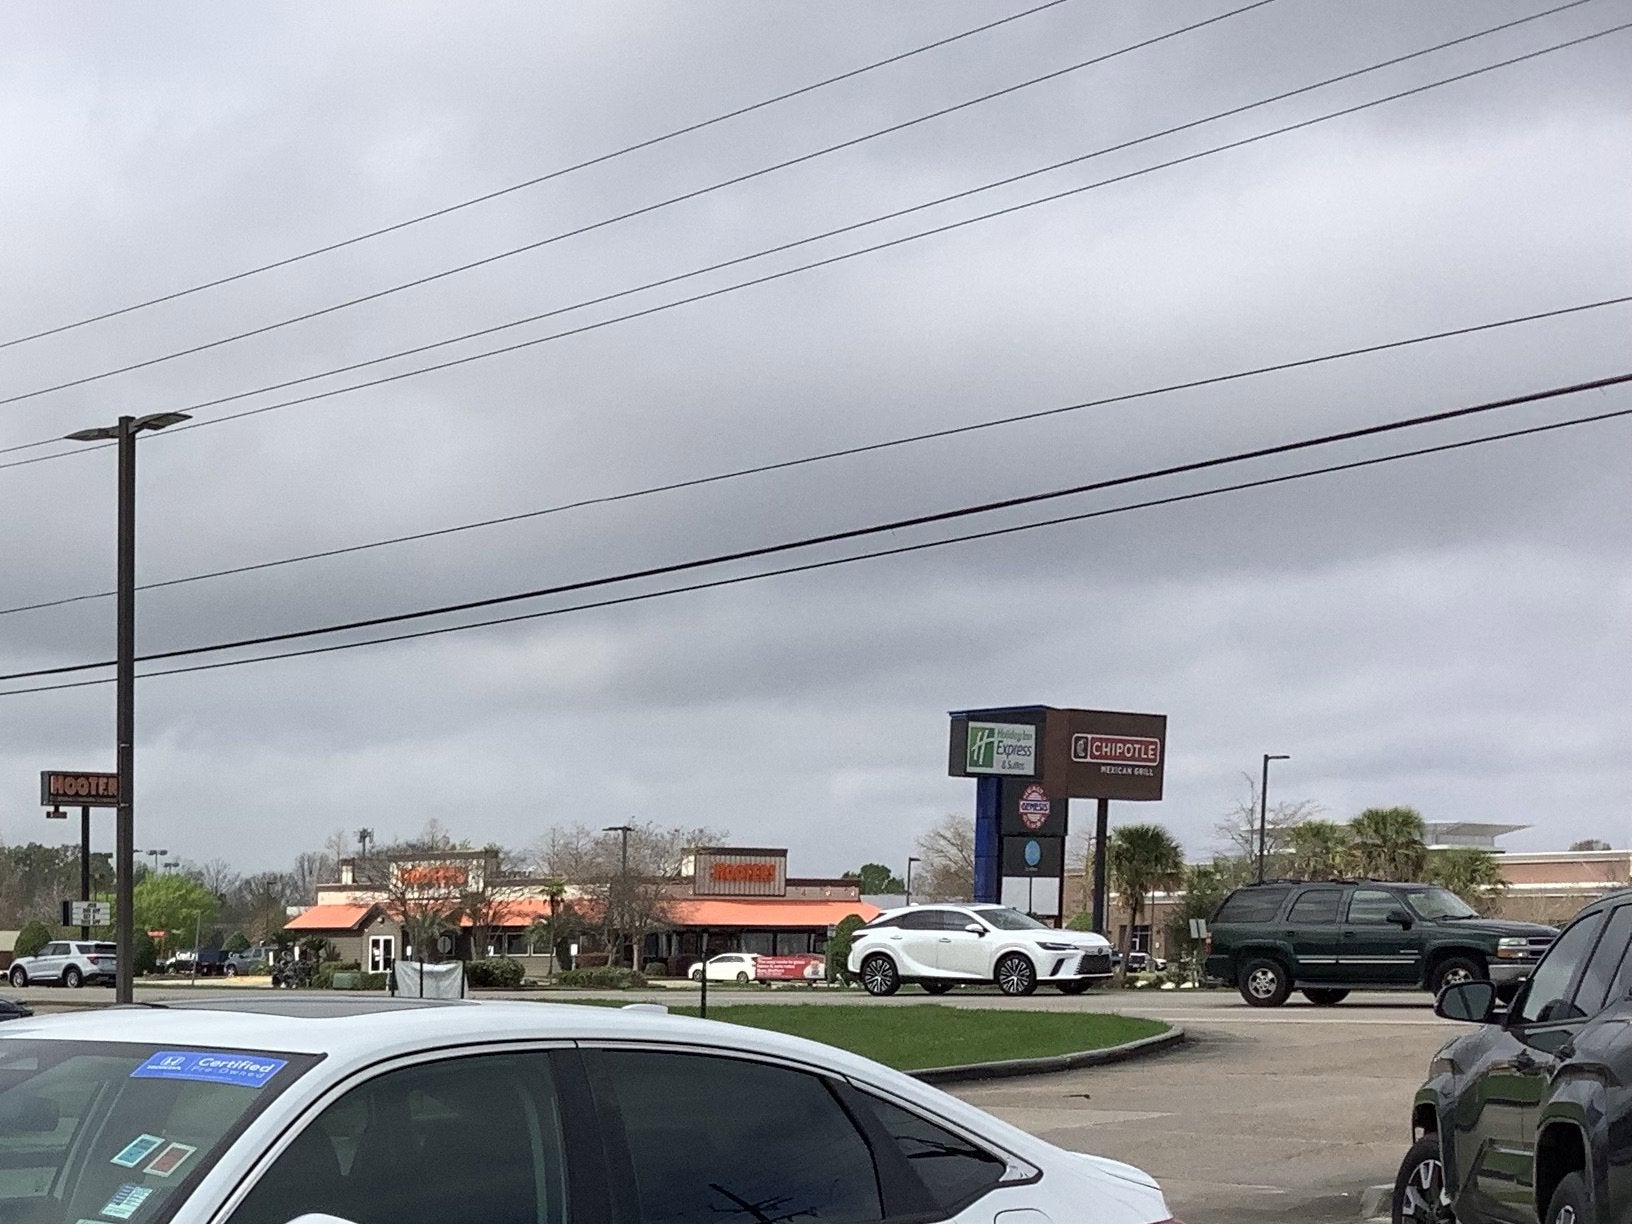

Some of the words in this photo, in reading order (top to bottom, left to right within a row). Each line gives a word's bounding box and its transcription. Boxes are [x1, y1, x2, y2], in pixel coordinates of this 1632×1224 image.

[996, 740, 1033, 759] Express
[1092, 741, 1156, 759] CHIPOTLE
[1100, 766, 1133, 775] MEXICAN
[1134, 767, 1154, 777] GRILL
[50, 775, 118, 796] HOOTER
[198, 1057, 275, 1073] Certified
